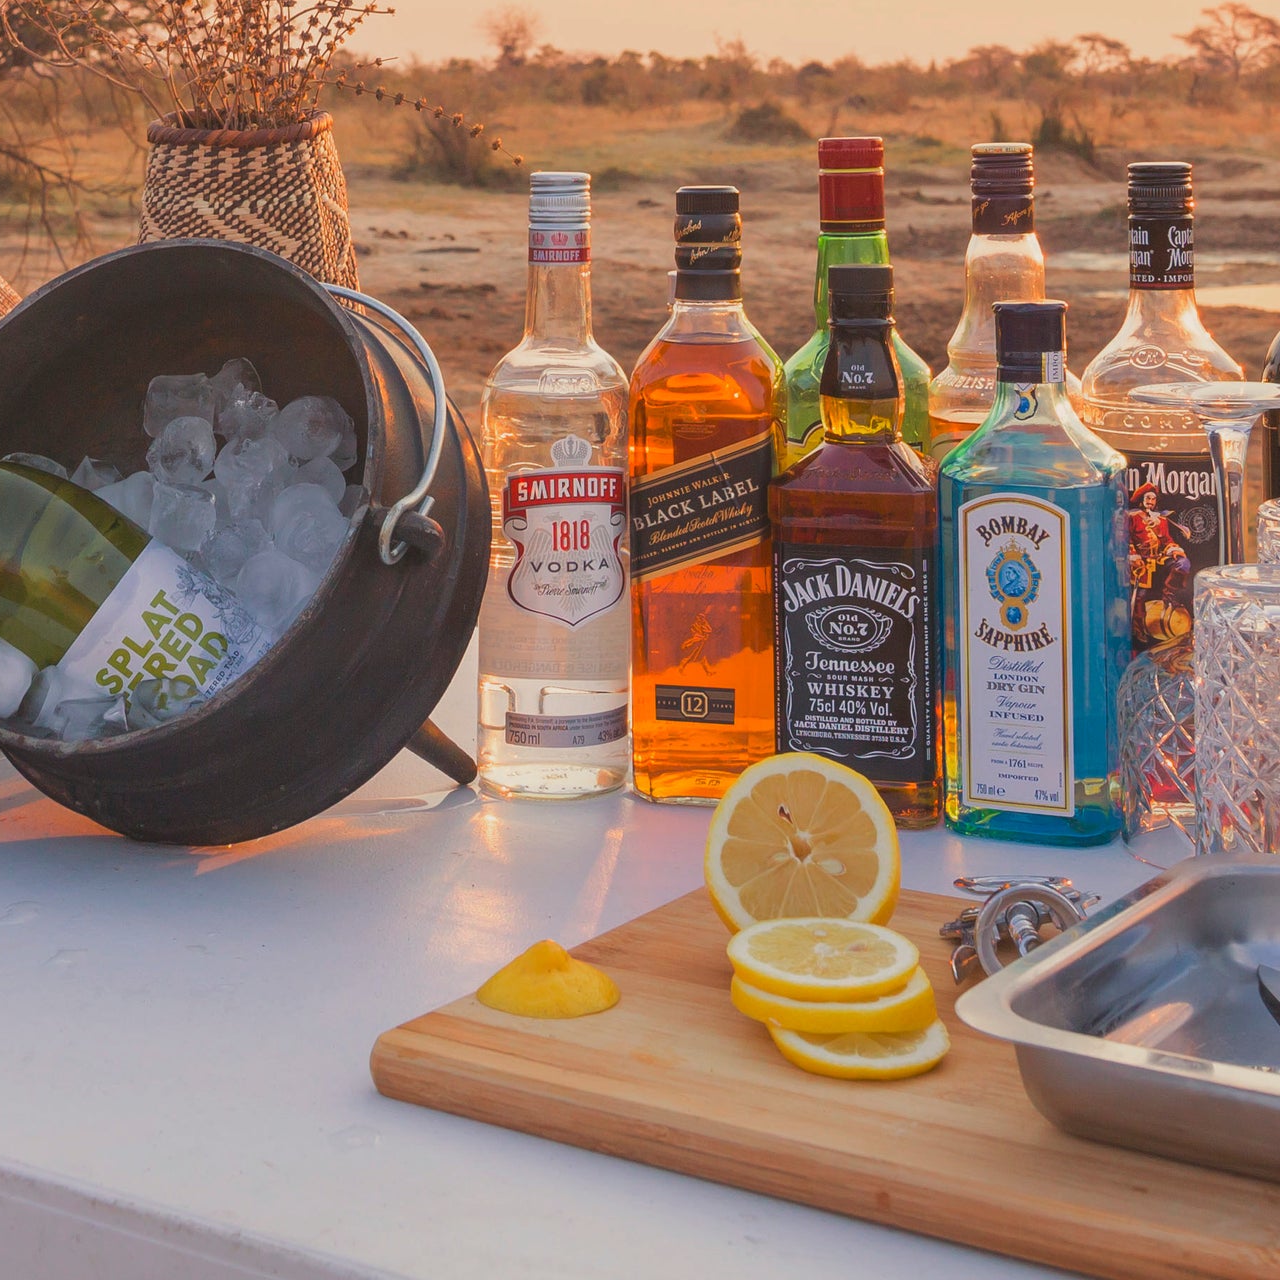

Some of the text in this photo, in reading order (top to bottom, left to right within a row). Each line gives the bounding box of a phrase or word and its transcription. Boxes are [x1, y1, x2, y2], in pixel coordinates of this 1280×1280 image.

[533, 250, 580, 261] SMIRNOFF
[1130, 249, 1151, 268] rgan
[1165, 248, 1194, 271] Morg
[841, 371, 873, 384] No.7
[518, 477, 616, 502] SMIRNOFF
[648, 485, 691, 508] JOHNNIE
[632, 478, 760, 532] BLACK LABEL
[649, 502, 753, 546] Blended Scotch Whisky
[552, 519, 590, 552] 1818
[976, 515, 1051, 550] BOMBAY
[530, 559, 609, 573] VODKA
[782, 565, 920, 618] JACK DANIEL'S
[838, 614, 858, 622] Old
[829, 621, 869, 636] No.7
[974, 618, 1055, 652] SAPPHIRE
[96, 589, 180, 695] SPLAT
[805, 651, 895, 674] Tennessee
[988, 656, 1044, 674] Distilled
[851, 675, 874, 683] MASH
[993, 673, 1039, 682] LONDON
[807, 682, 894, 699] WHISKEY
[987, 681, 1046, 695] DRY GIN
[687, 696, 703, 712] 12
[809, 698, 893, 716] 75cl 40% Vol.
[996, 695, 1037, 711] Vapour
[805, 715, 839, 723] DISTILLED
[856, 718, 886, 726] BOTTLED
[989, 711, 1044, 722] INFUSED
[794, 721, 909, 735] JACK DANIEL DISTILLERY
[509, 730, 540, 745] 750 ml
[572, 735, 585, 745] A79
[834, 732, 871, 741] TENNESSEE
[1009, 758, 1027, 768] 1761
[998, 772, 1039, 782] IMPORTED
[976, 783, 987, 795] 750
[988, 784, 995, 795] ml
[1034, 789, 1059, 802] 47% vol
